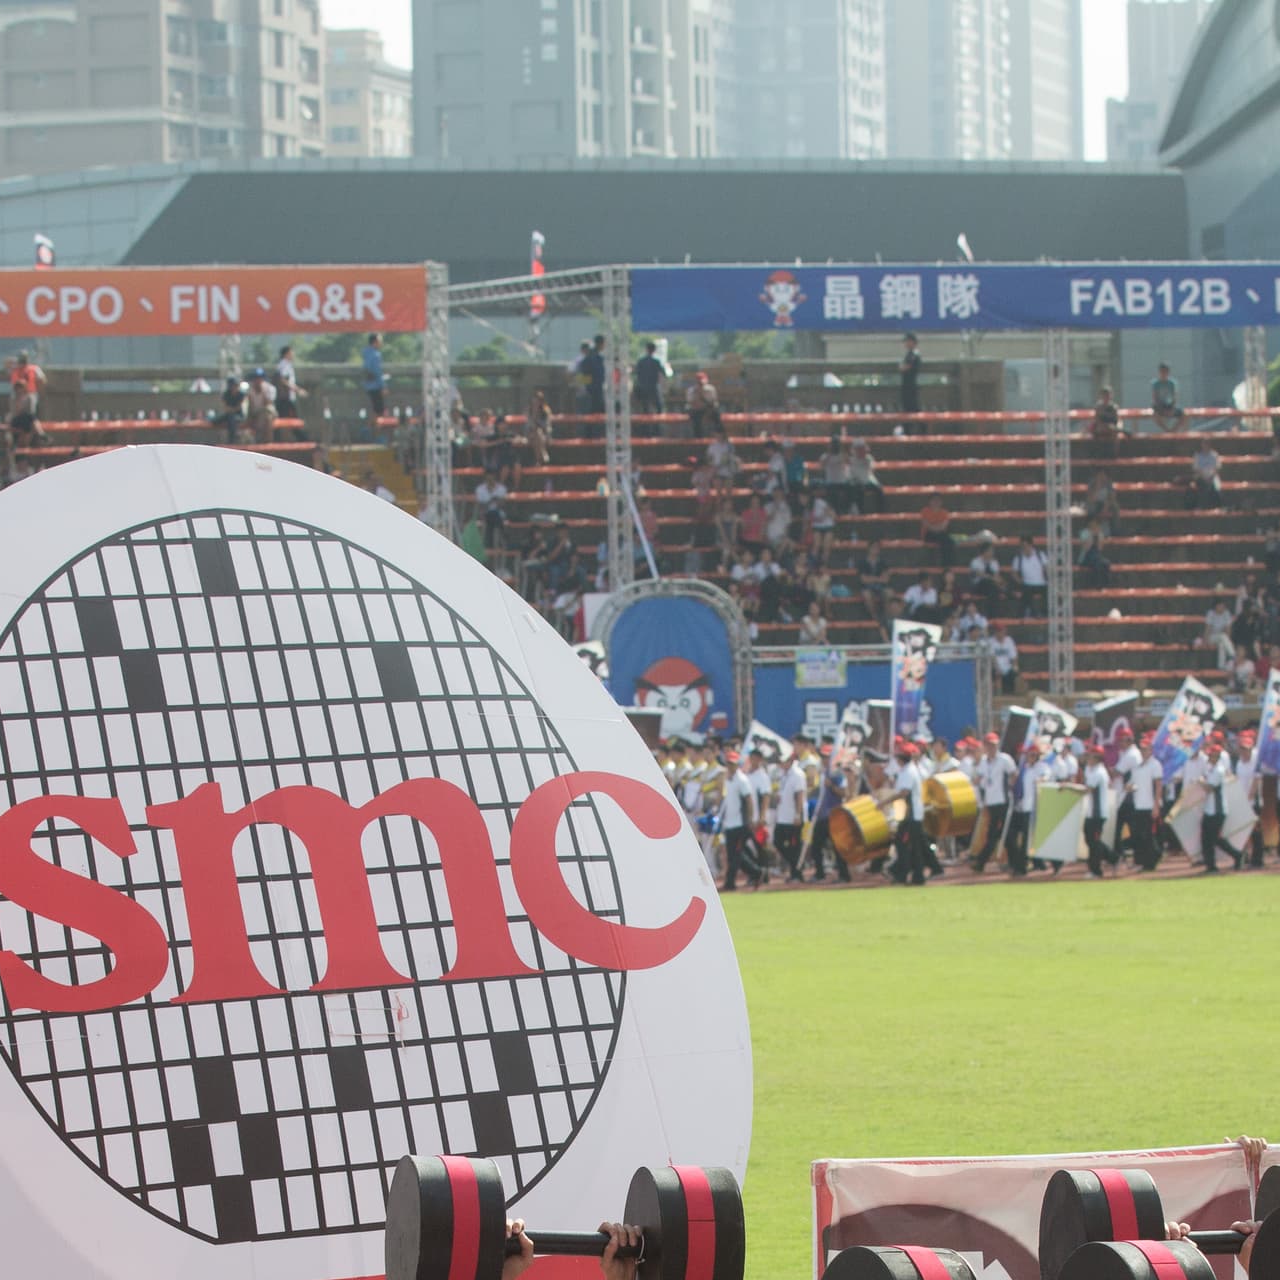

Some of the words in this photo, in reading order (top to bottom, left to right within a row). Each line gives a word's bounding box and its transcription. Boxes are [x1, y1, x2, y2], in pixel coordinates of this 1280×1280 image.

[25, 285, 123, 325] CPO
[169, 284, 240, 324] FIN
[285, 283, 385, 323] Q&R
[822, 273, 981, 321] 晶鋼隊
[1069, 278, 1231, 317] FAB12B
